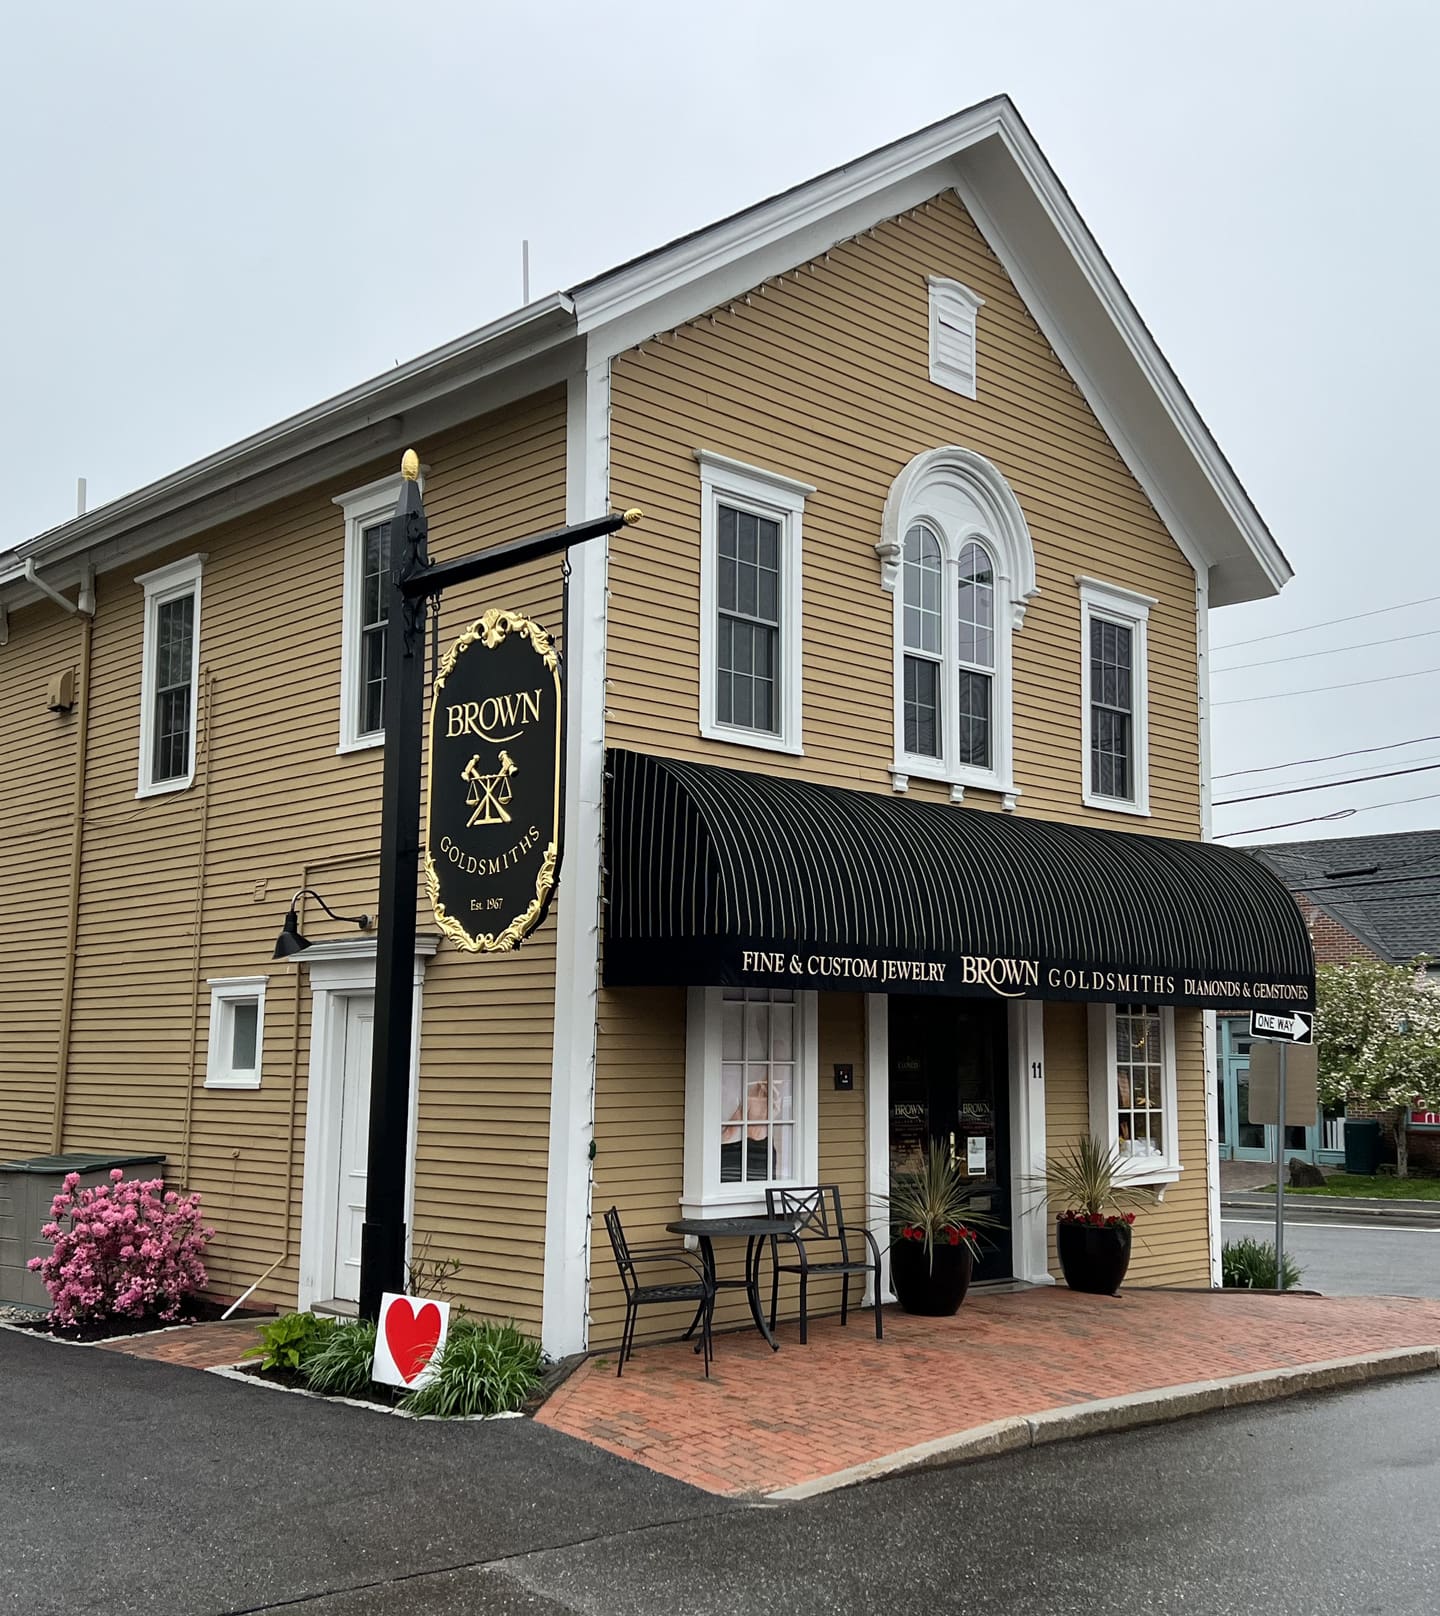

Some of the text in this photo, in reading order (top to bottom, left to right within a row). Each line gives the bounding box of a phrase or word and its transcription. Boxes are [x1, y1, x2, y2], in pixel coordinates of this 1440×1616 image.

[446, 688, 542, 743] BROWN
[440, 825, 541, 876] GOLDSMITHS
[486, 898, 503, 911] 1967
[742, 951, 1309, 1001] FINE & CUSTOM JEWELRY BROWN GOLDSMITHS DIAMONDS & GEMSTONES
[1257, 1015, 1295, 1032] ONE WAY
[1032, 1061, 1043, 1079] 11
[894, 1103, 925, 1119] BROWN
[962, 1103, 990, 1117] BROWN
